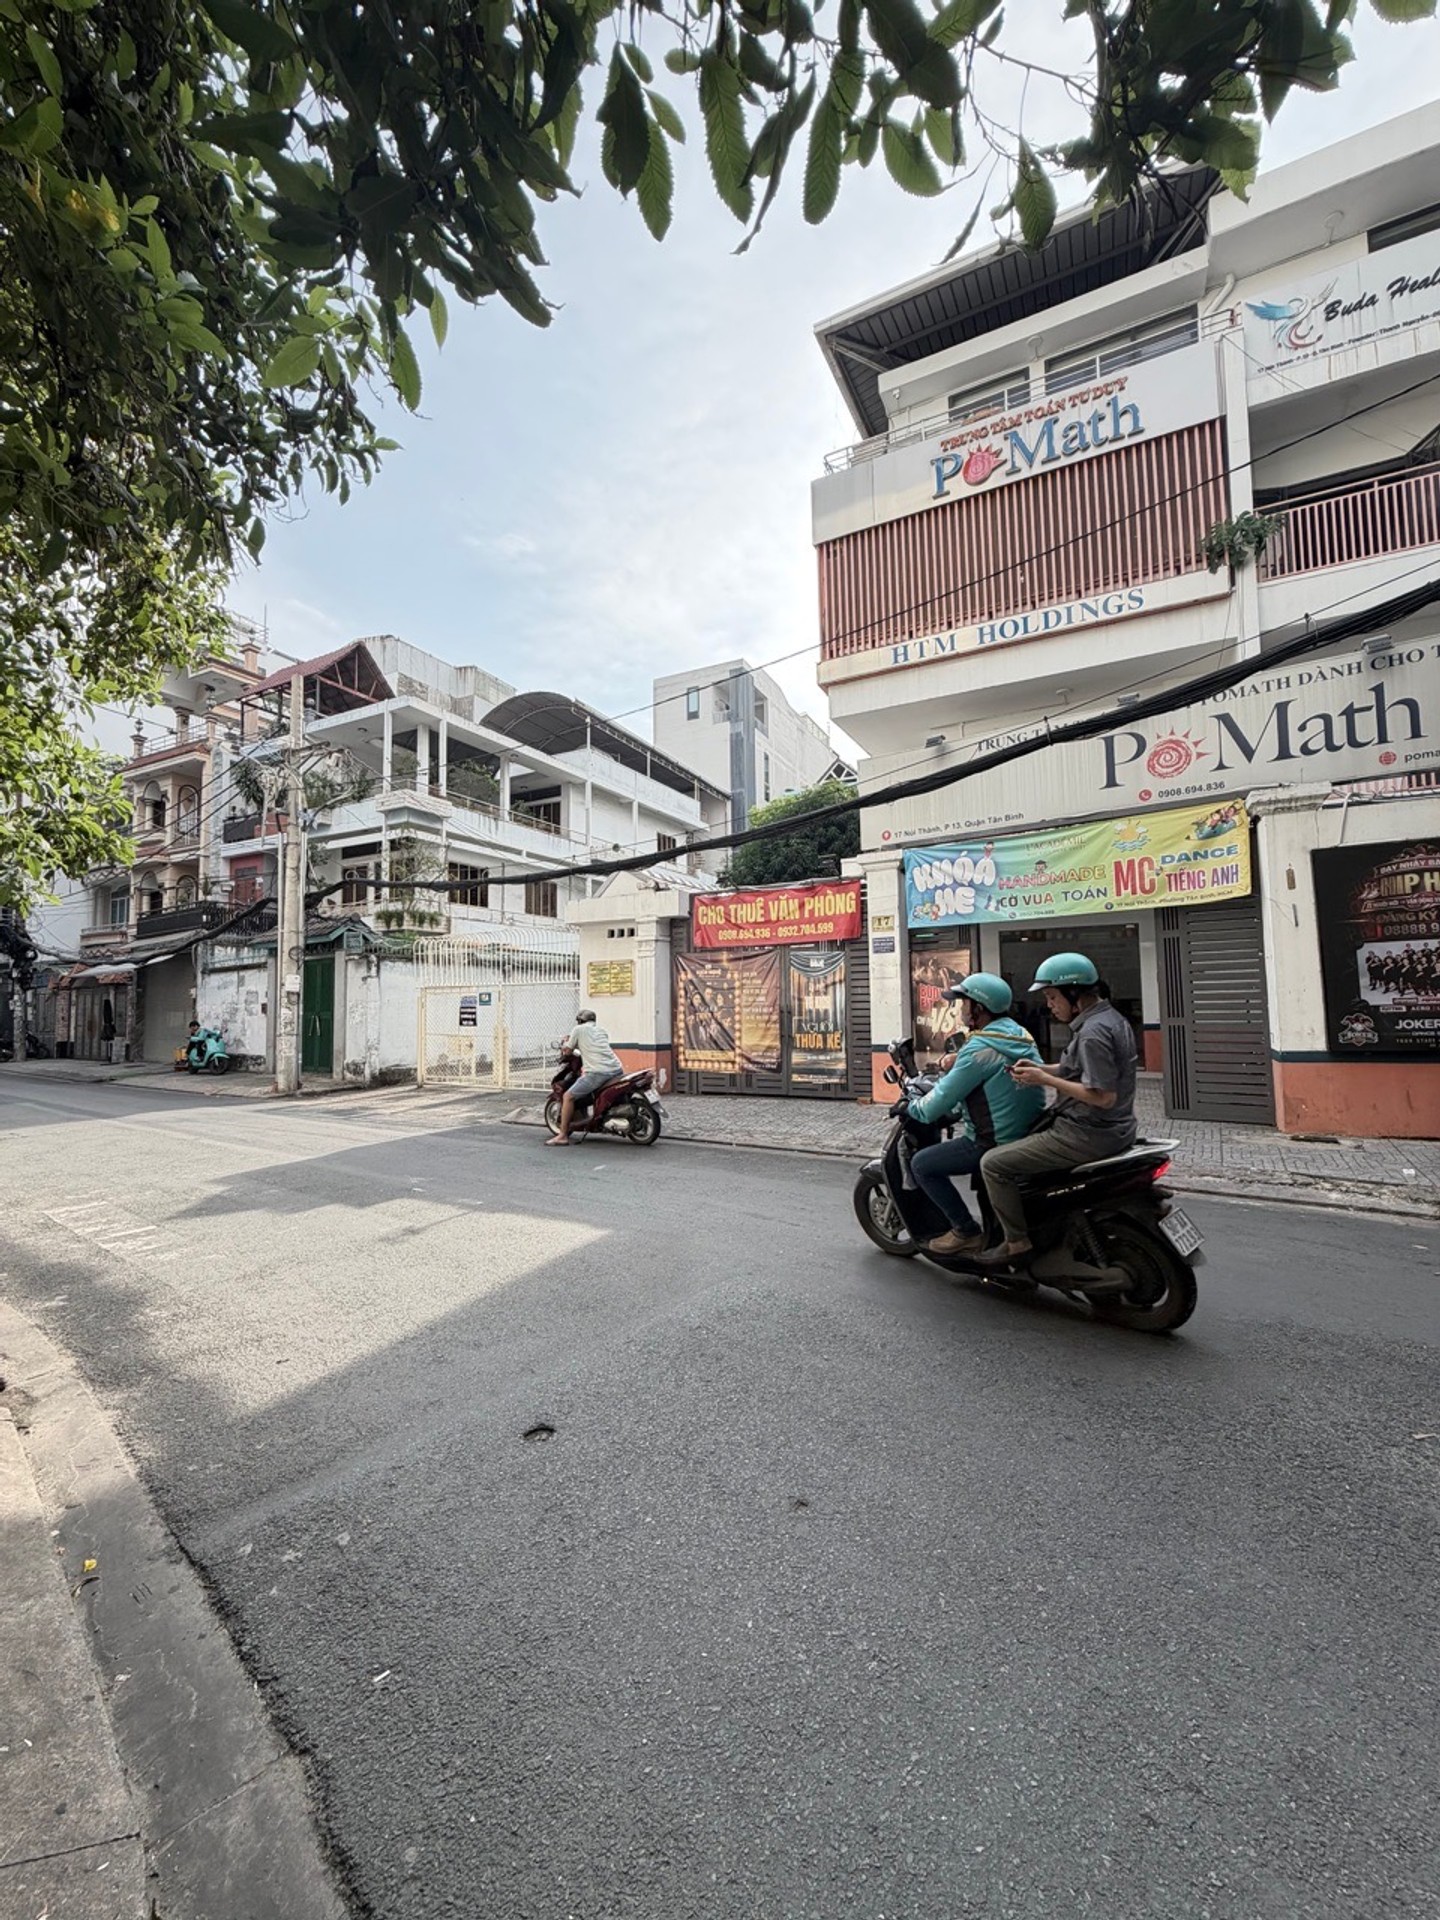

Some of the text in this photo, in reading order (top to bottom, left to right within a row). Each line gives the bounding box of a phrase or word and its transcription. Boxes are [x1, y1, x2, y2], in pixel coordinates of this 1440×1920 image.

[1324, 292, 1379, 322] Buda
[941, 426, 990, 452] TRUNG
[991, 414, 1023, 435] TÂM
[1024, 398, 1067, 424] TOÁN
[1092, 375, 1129, 401] DUY
[891, 588, 1144, 665] HTM HOLDINGS
[1299, 660, 1363, 685] DÀNH
[1370, 648, 1425, 671] CHO
[1157, 780, 1226, 798] 0908.694.836
[987, 816, 1003, 825] Tân
[1160, 844, 1239, 865] DANCE
[998, 864, 1107, 890] HANDMADE
[1113, 856, 1157, 898] MC
[1165, 863, 1239, 892] TIẾNG ANH
[1381, 873, 1420, 897] HIP
[698, 889, 857, 926] CHO THUÊ VĂN PHÒNG
[1022, 891, 1054, 906] VUA
[1061, 885, 1107, 901] TOÁN
